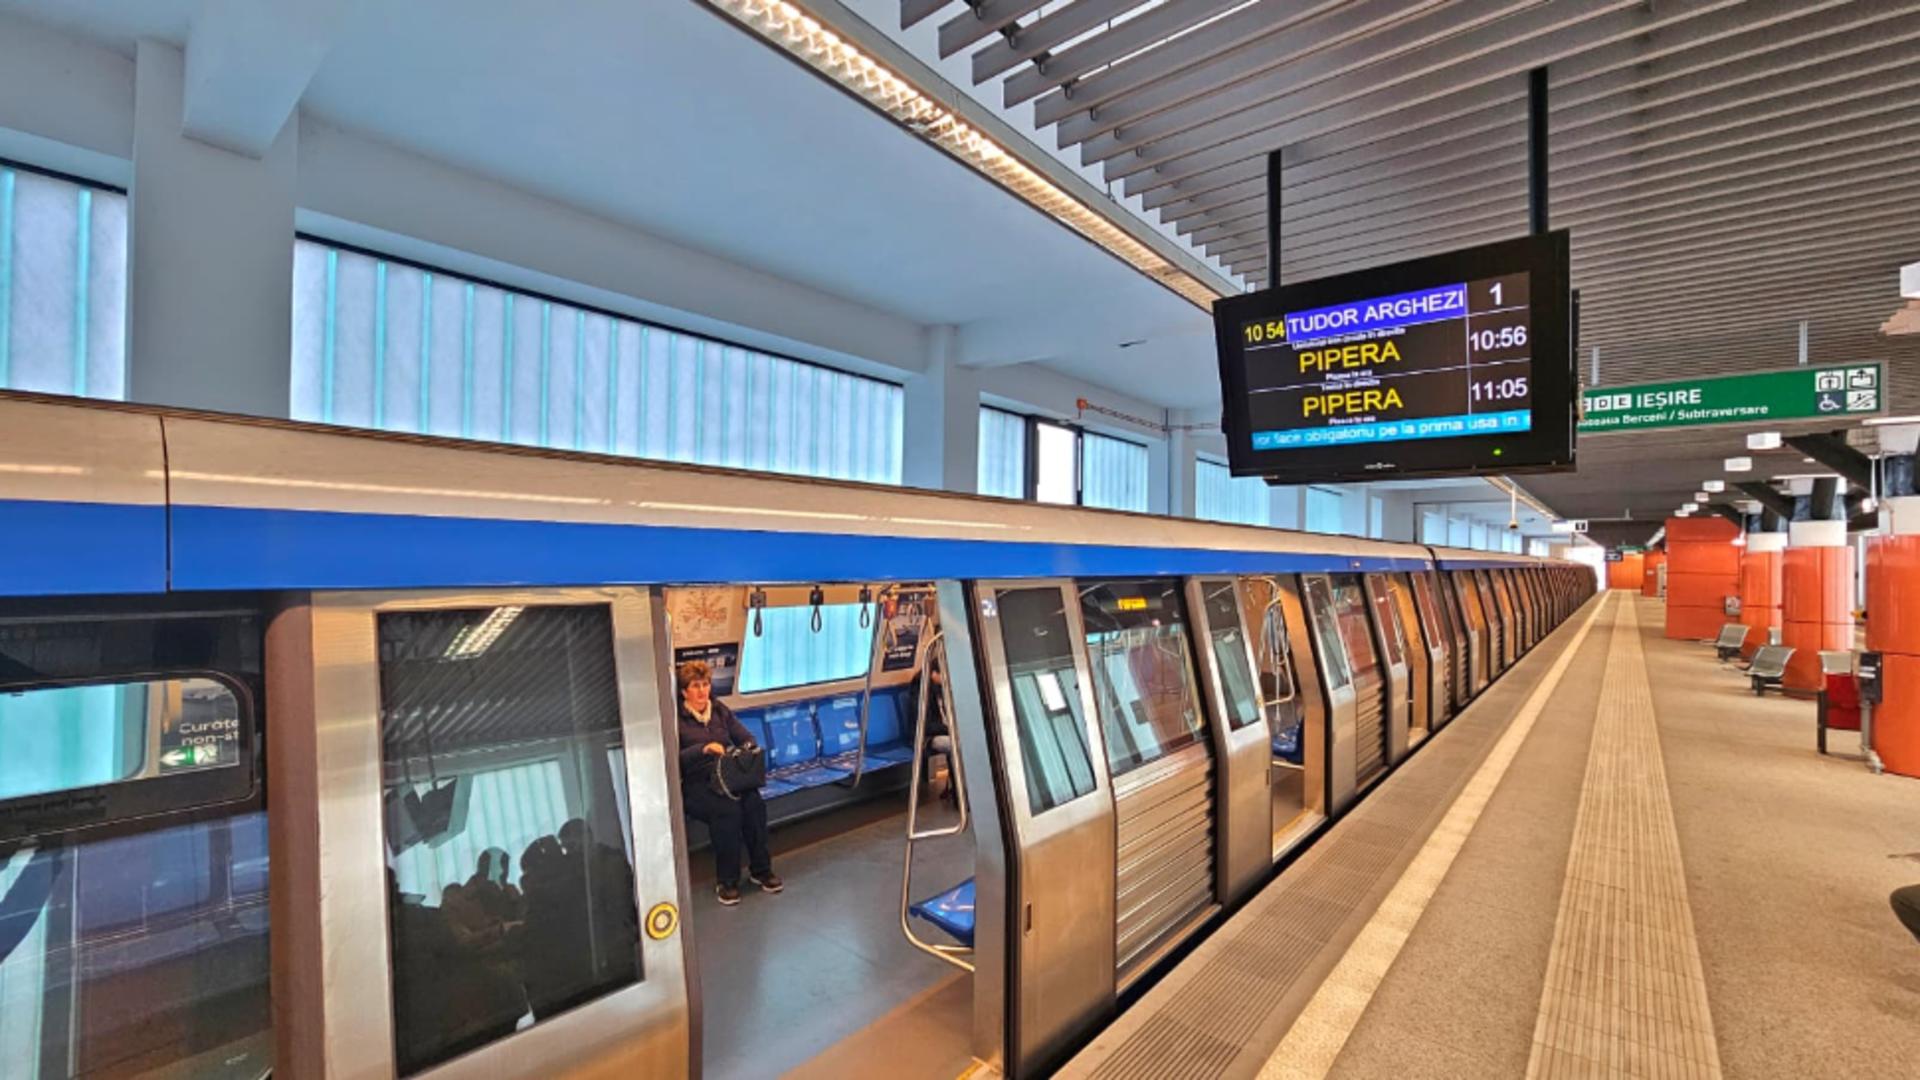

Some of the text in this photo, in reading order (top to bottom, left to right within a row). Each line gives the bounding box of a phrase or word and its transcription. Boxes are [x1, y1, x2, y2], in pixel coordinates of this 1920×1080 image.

[1489, 282, 1502, 305] 1
[1288, 290, 1464, 334] TUDOR ARGHEZI
[1244, 323, 1263, 342] 10
[1266, 321, 1285, 340] 54
[1470, 325, 1528, 351] 10:56
[1299, 340, 1402, 373] PIPERA
[1471, 377, 1529, 401] 11:05
[1303, 387, 1404, 418] PIPERA
[1622, 411, 1668, 424] Berceni
[1677, 405, 1769, 420] Subtraversare
[1378, 425, 1398, 440] pe
